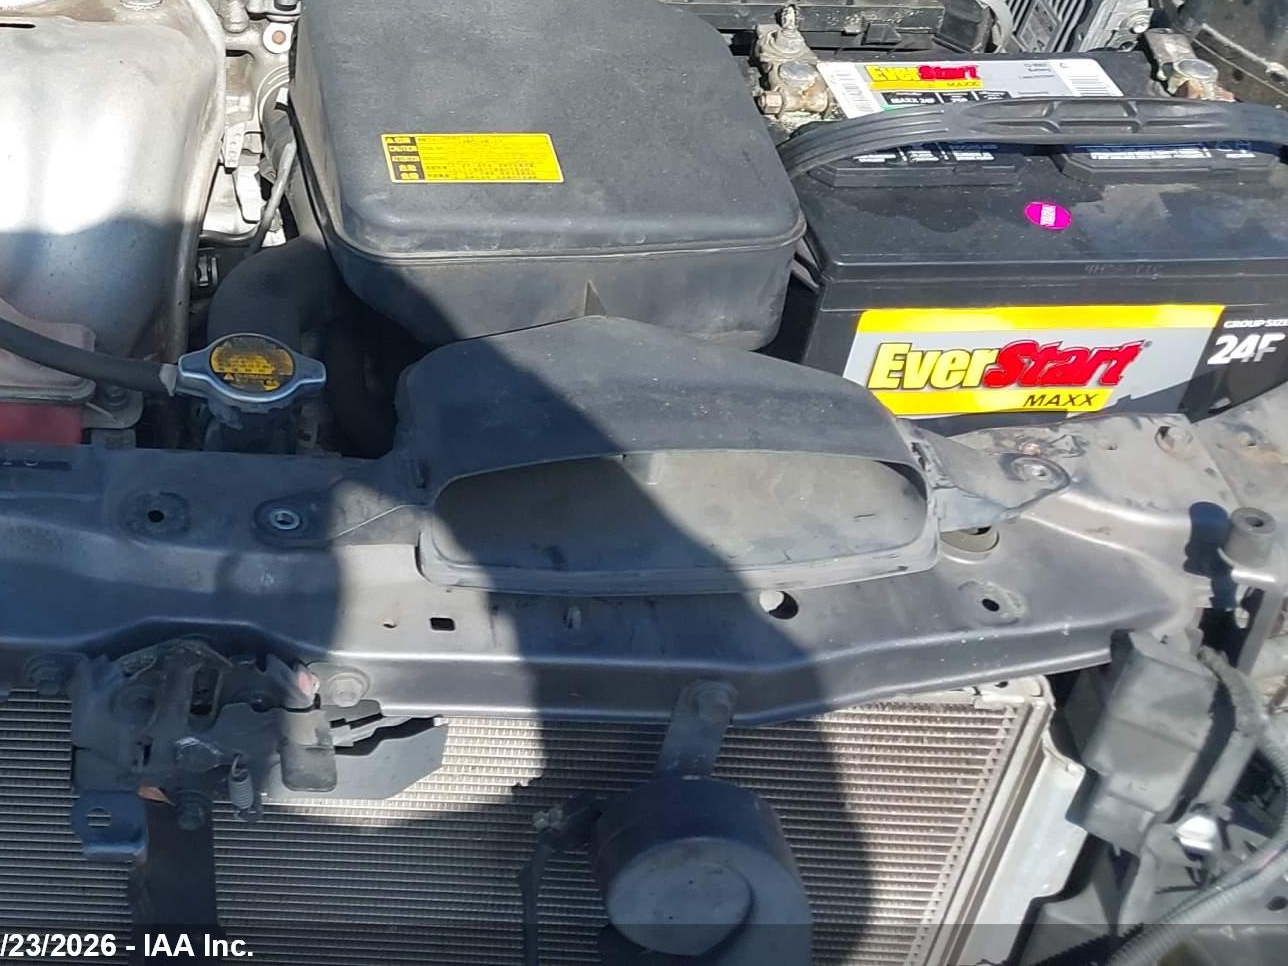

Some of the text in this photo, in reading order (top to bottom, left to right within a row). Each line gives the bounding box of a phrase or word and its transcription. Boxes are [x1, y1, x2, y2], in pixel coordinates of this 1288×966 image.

[864, 65, 978, 82] EverStart
[1223, 320, 1264, 329] GROUP
[1207, 332, 1287, 365] 24F
[866, 340, 1146, 390] EverStart
[1022, 393, 1098, 408] MAXX
